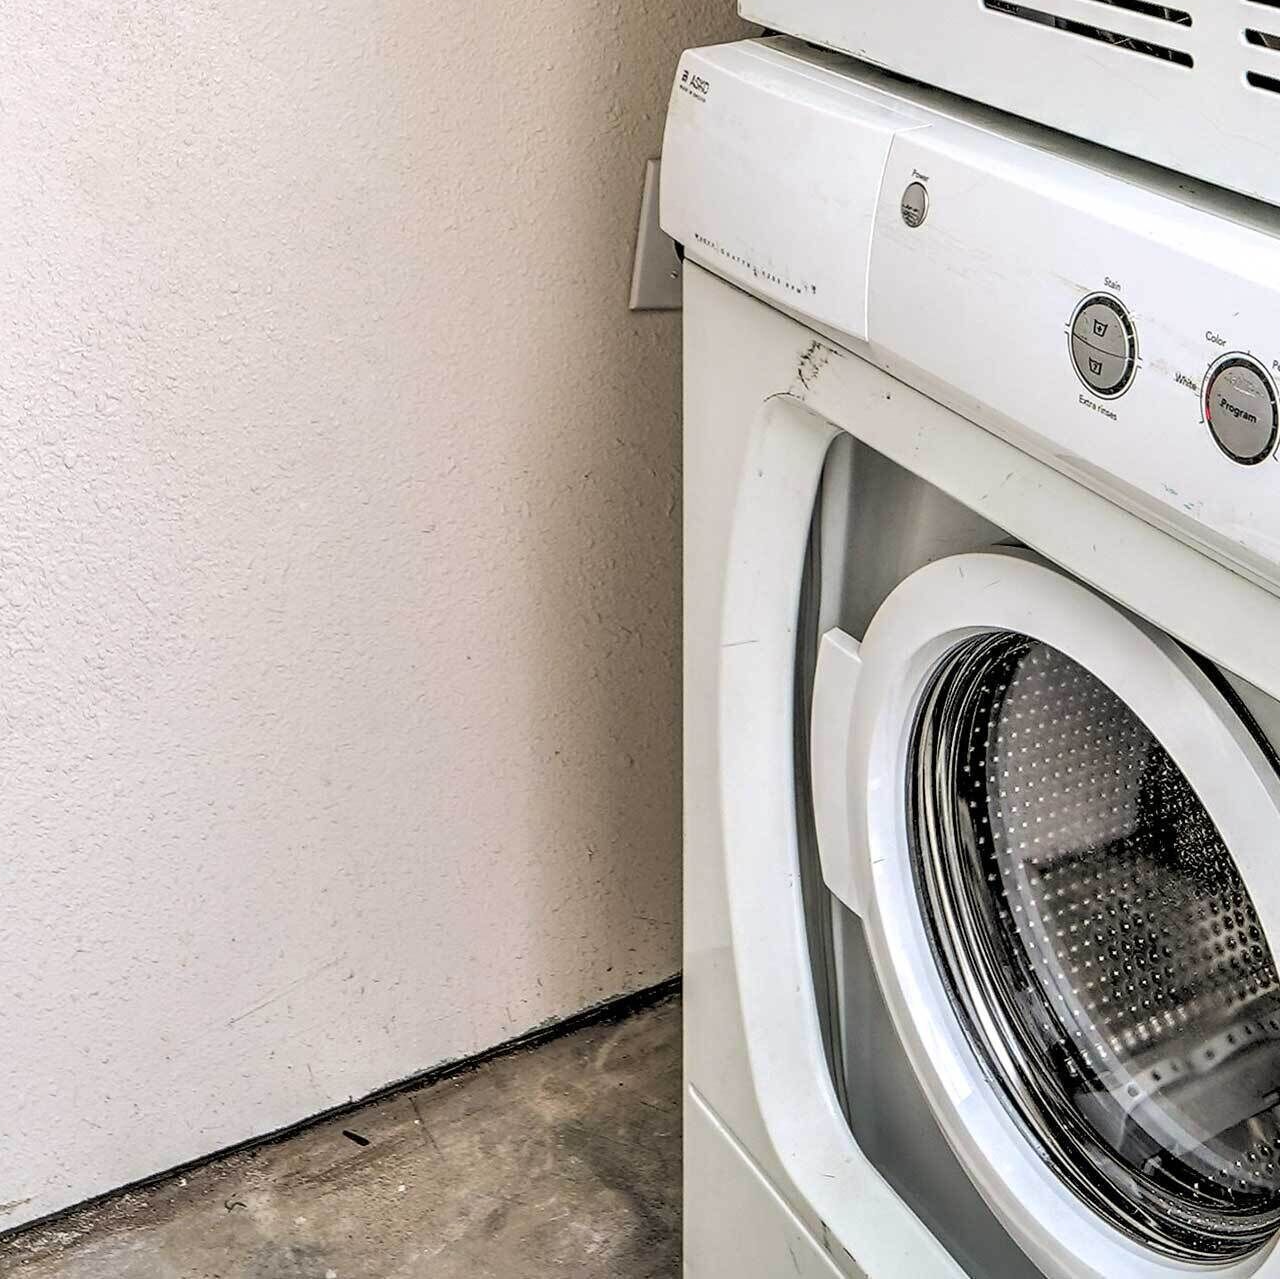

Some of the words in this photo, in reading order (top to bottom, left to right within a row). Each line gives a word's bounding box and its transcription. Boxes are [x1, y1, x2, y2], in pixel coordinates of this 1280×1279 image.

[911, 168, 930, 181] Power
[1104, 276, 1122, 291] Stain
[1205, 330, 1227, 347] Color
[1174, 371, 1197, 391] White
[1078, 393, 1097, 411] Extra
[1097, 404, 1118, 421] rinses
[1219, 397, 1257, 424] Program
